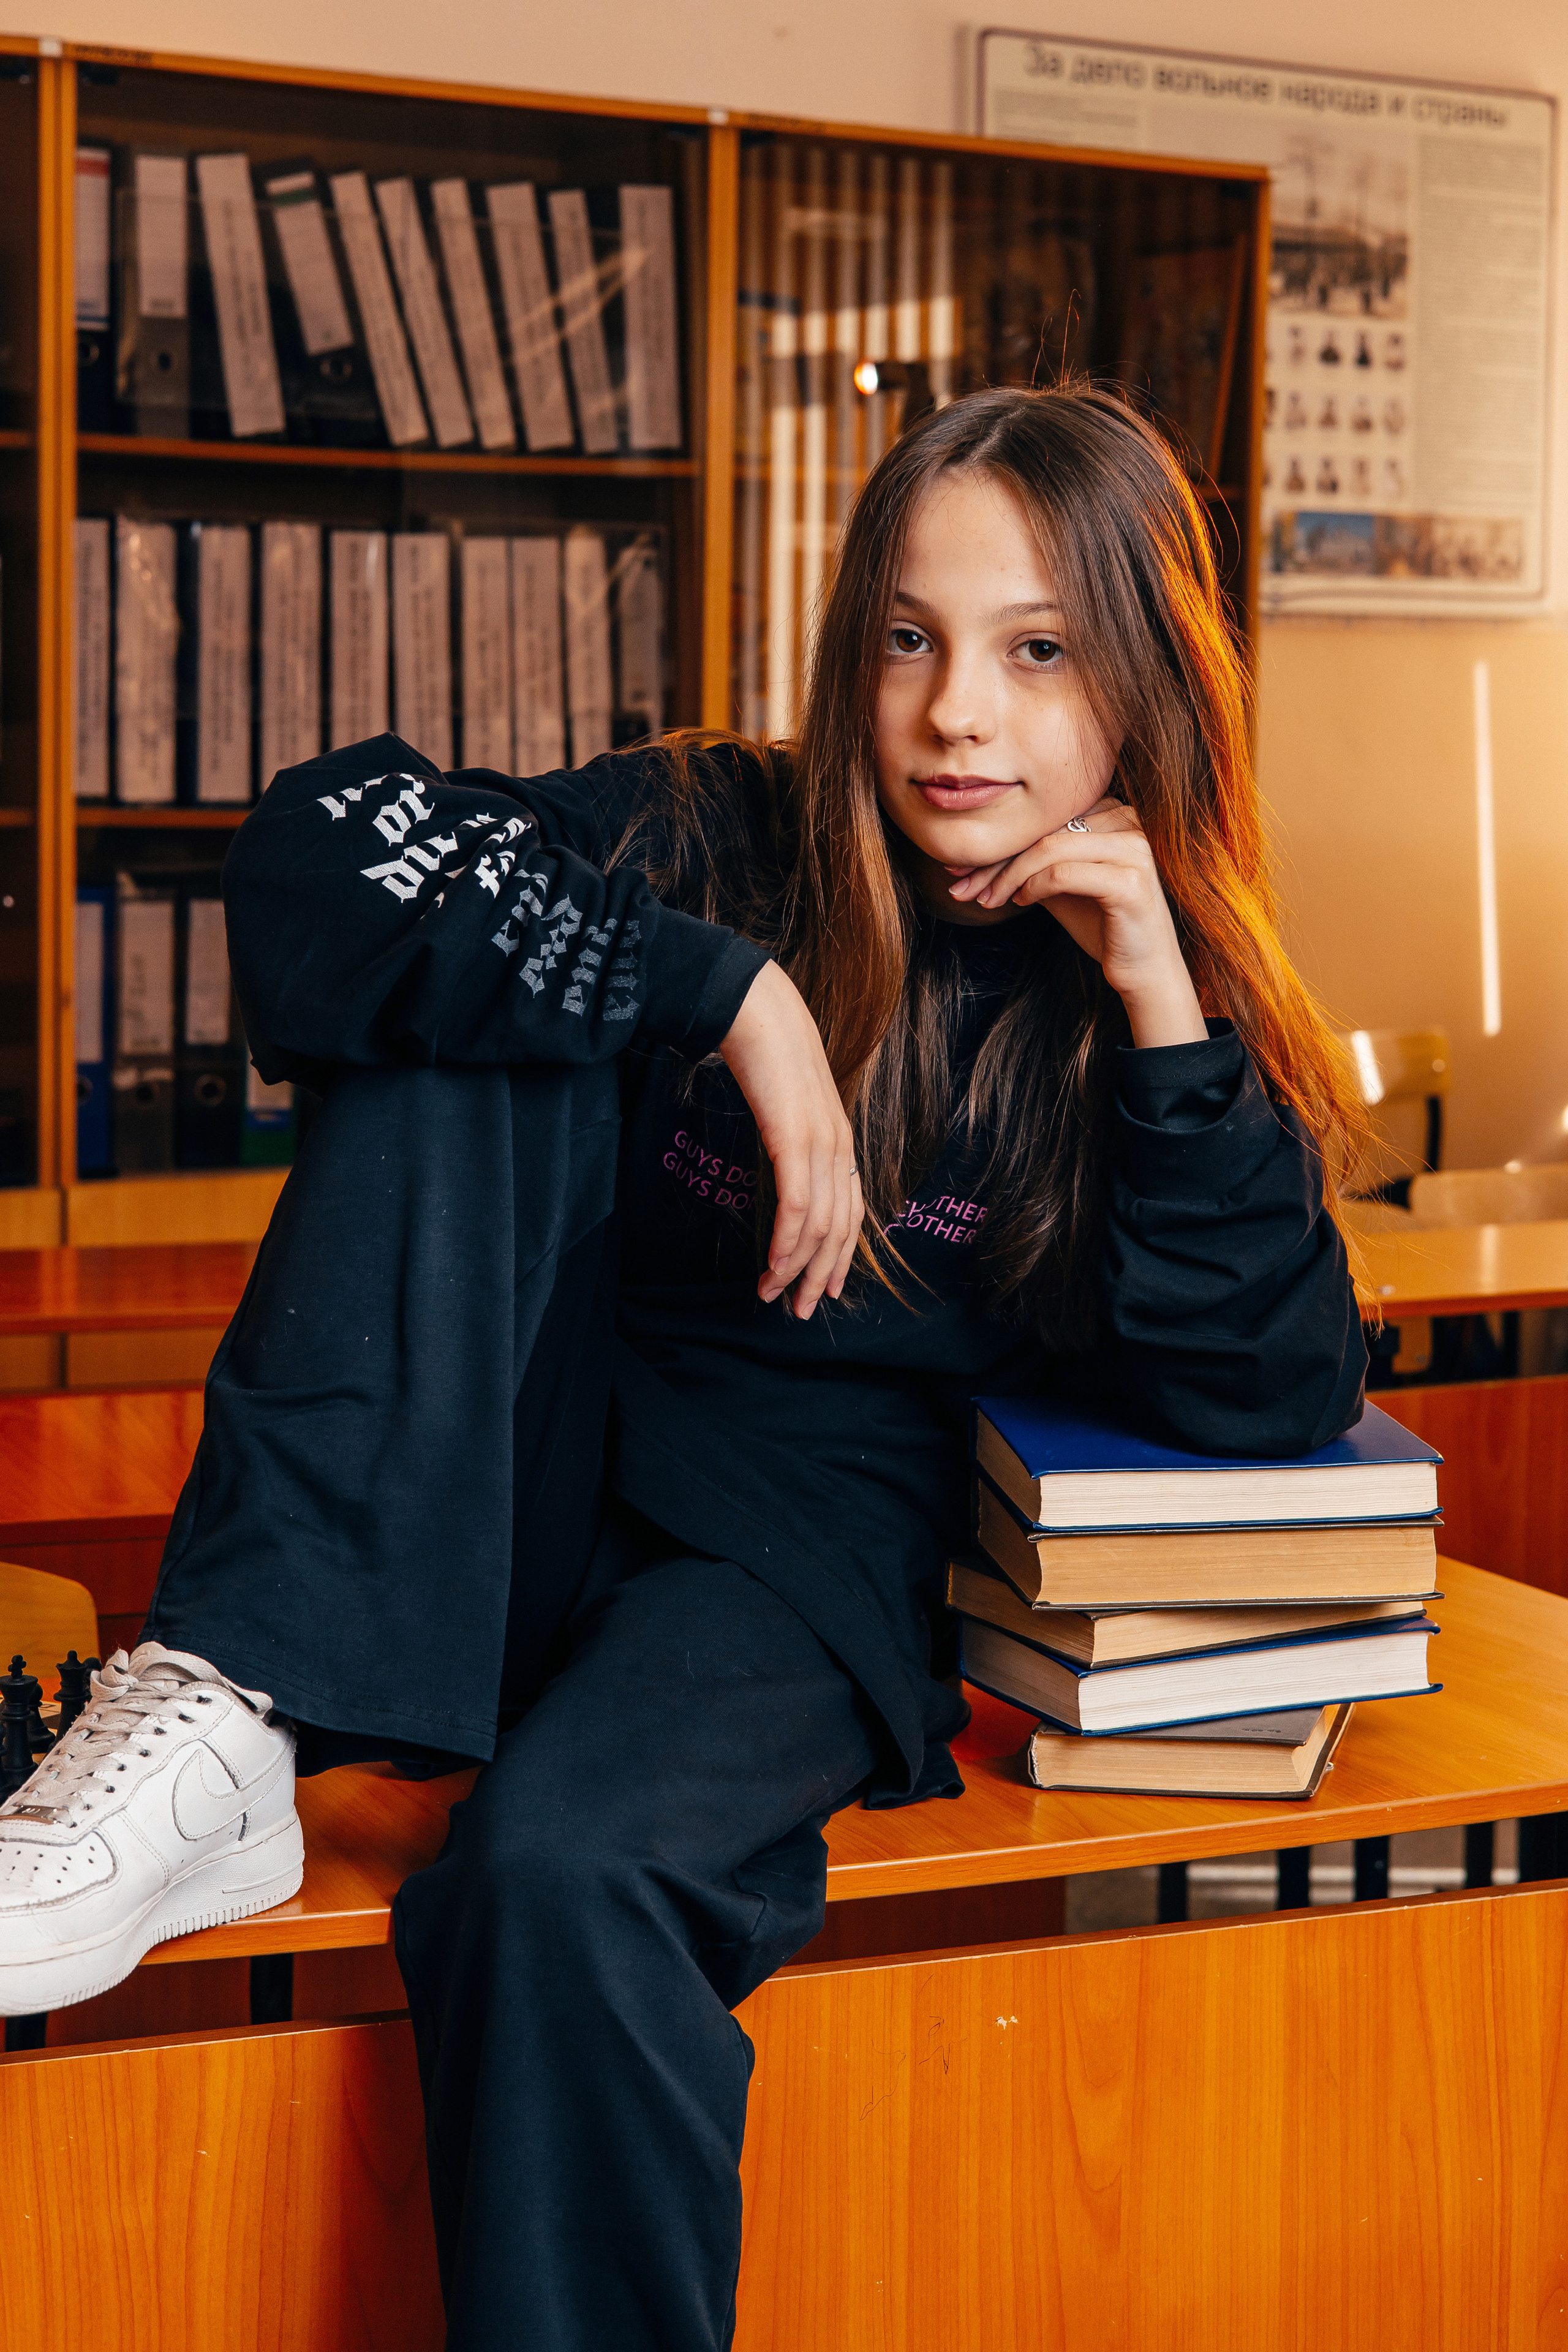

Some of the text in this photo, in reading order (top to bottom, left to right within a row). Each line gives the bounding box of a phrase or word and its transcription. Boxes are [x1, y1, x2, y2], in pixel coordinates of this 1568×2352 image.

[1025, 42, 1062, 77] За
[1071, 57, 1145, 87] дело
[1282, 84, 1378, 115] народа
[1389, 96, 1406, 115] и
[1413, 98, 1507, 127] страны
[674, 1131, 723, 1175] GUYS
[663, 1152, 755, 1210] GUYS DO
[906, 1213, 978, 1245] OTHER
[924, 1196, 988, 1224] THER
